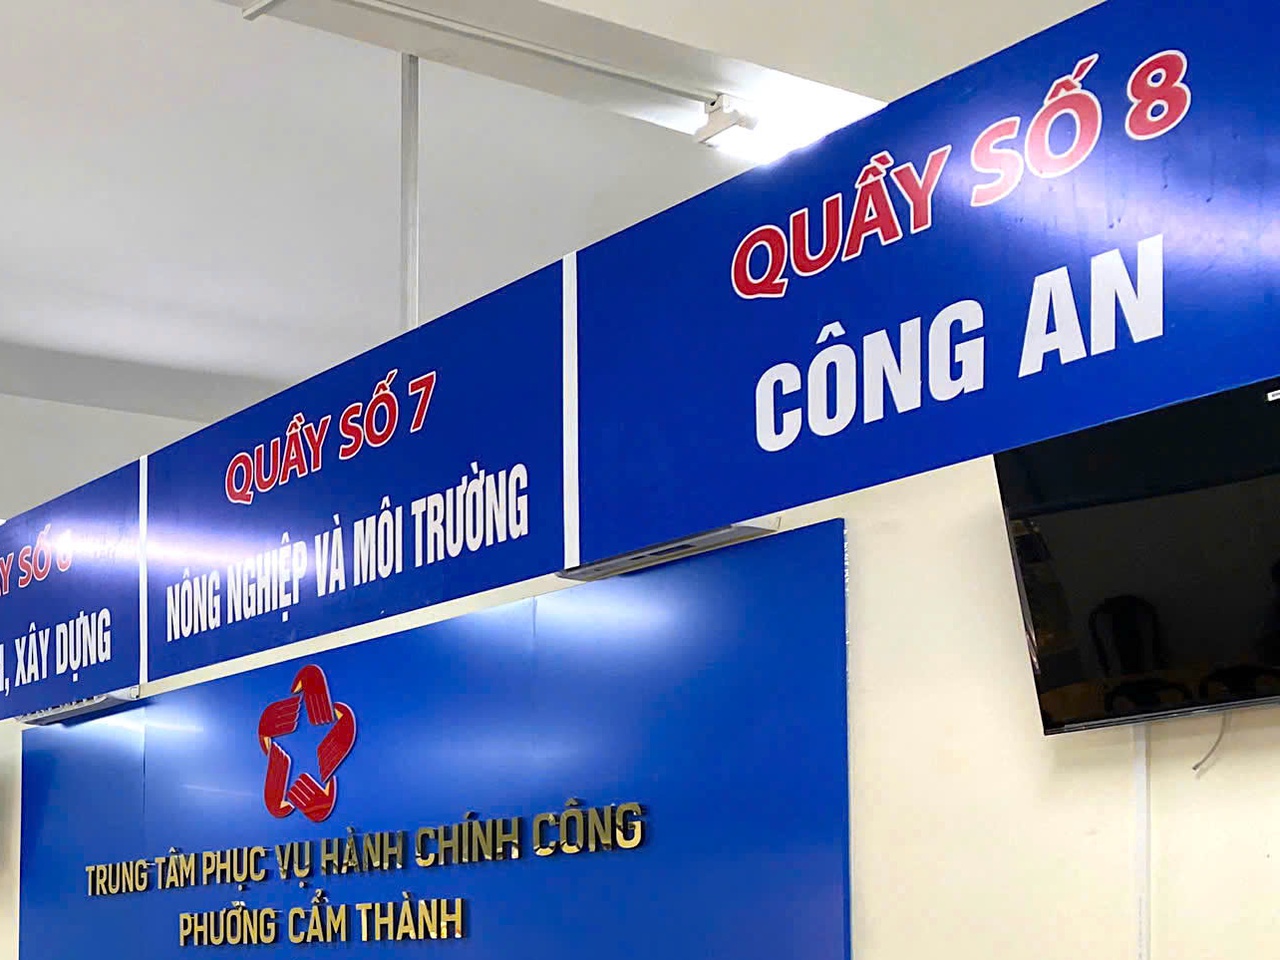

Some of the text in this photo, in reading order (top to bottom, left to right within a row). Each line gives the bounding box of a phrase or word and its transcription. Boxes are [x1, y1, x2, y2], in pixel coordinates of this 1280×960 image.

[731, 50, 1192, 299] QUẦY SỐ 8
[755, 234, 1164, 453] CÔNG AN
[225, 369, 437, 506] QUẦY SỐ 7
[18, 523, 52, 588] SỐ
[166, 461, 529, 642] NÔNG NGHIỆP VÀ MÔI TRƯỜNG
[15, 621, 50, 688] XÂY
[56, 608, 112, 682] DỰNG
[85, 797, 643, 896] TRUNG TÂM PHỤC VỤ HÀNH CHÍNH CÔNG
[179, 889, 462, 946] PHƯỜNG CẨM THÀNH
